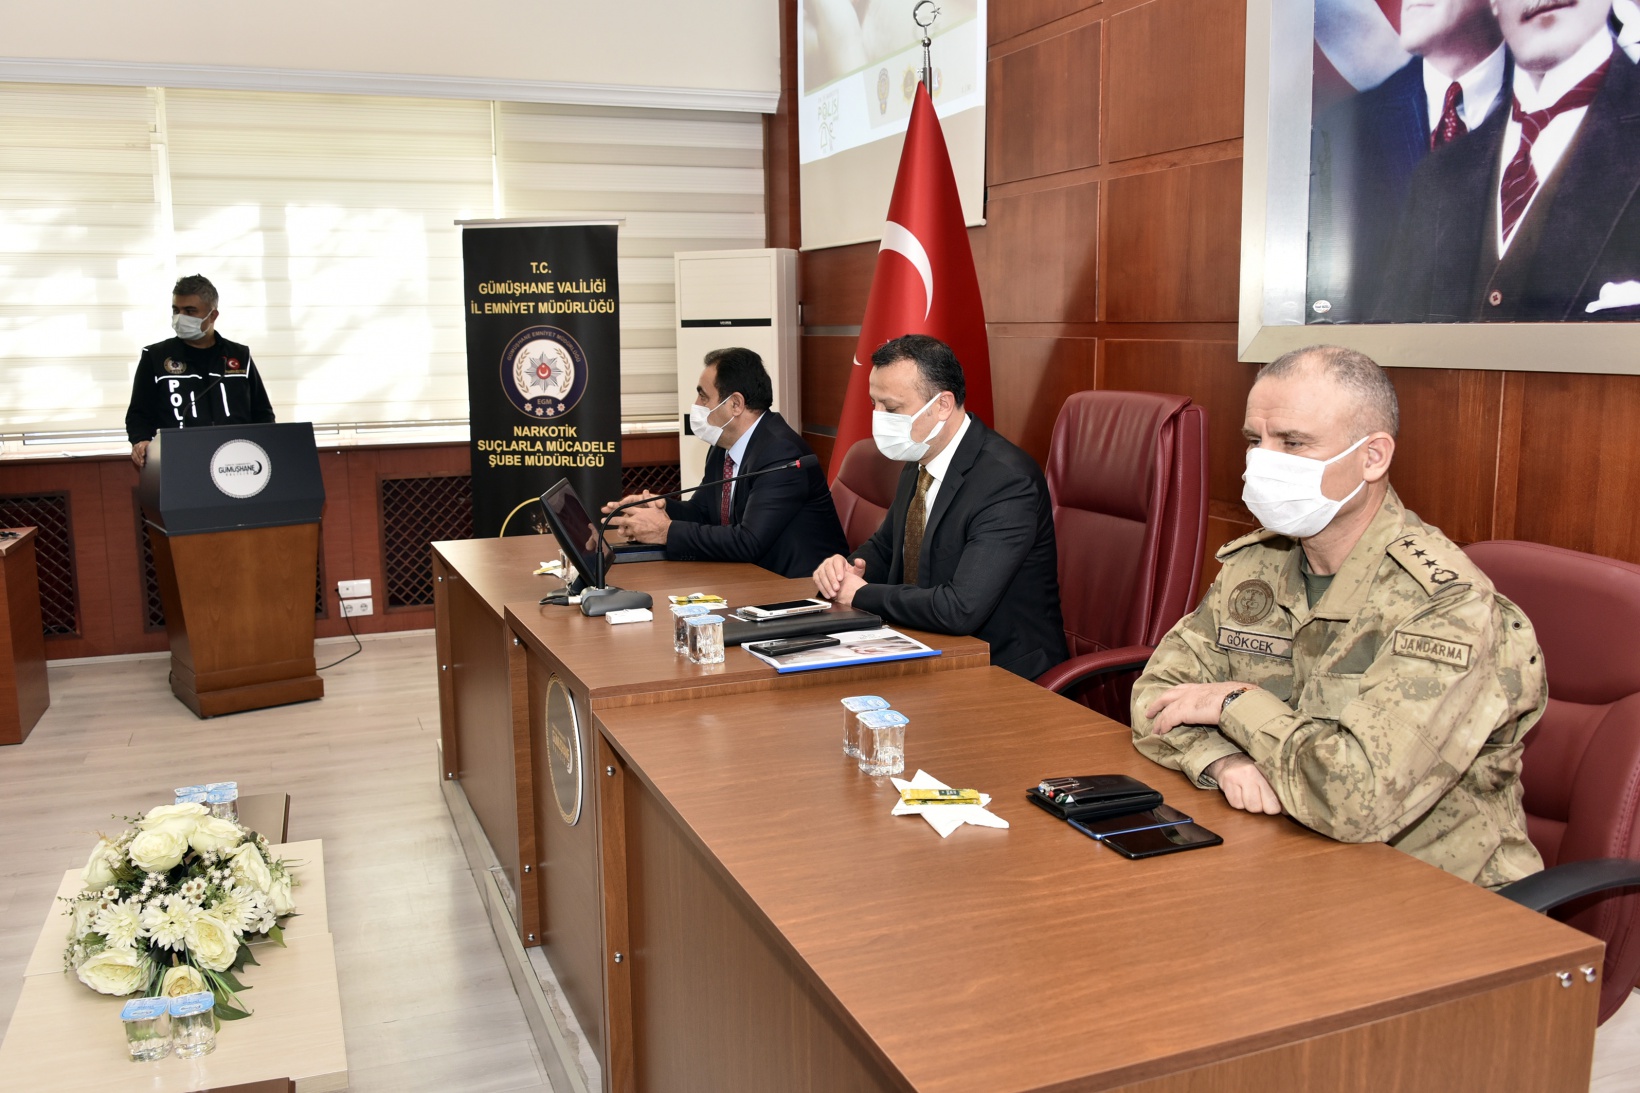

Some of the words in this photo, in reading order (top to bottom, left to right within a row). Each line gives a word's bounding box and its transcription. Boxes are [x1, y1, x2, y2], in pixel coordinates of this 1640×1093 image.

[530, 262, 552, 274] T.C.
[478, 281, 554, 296] GÜMÜŞHANE
[557, 278, 607, 294] VALİLİĞİ
[471, 300, 482, 315] İL
[484, 300, 536, 314] EMNİYET
[538, 299, 615, 314] MÜDÜRLÜĞÜ
[513, 424, 577, 437] NARKOTİK
[477, 440, 543, 453] SUÇLARLA
[546, 439, 616, 453] MÜCADELE
[488, 455, 522, 468] ŞUBE
[524, 453, 605, 467] MÜDÜRLÜĞÜ
[1400, 637, 1463, 661] JANDARMA
